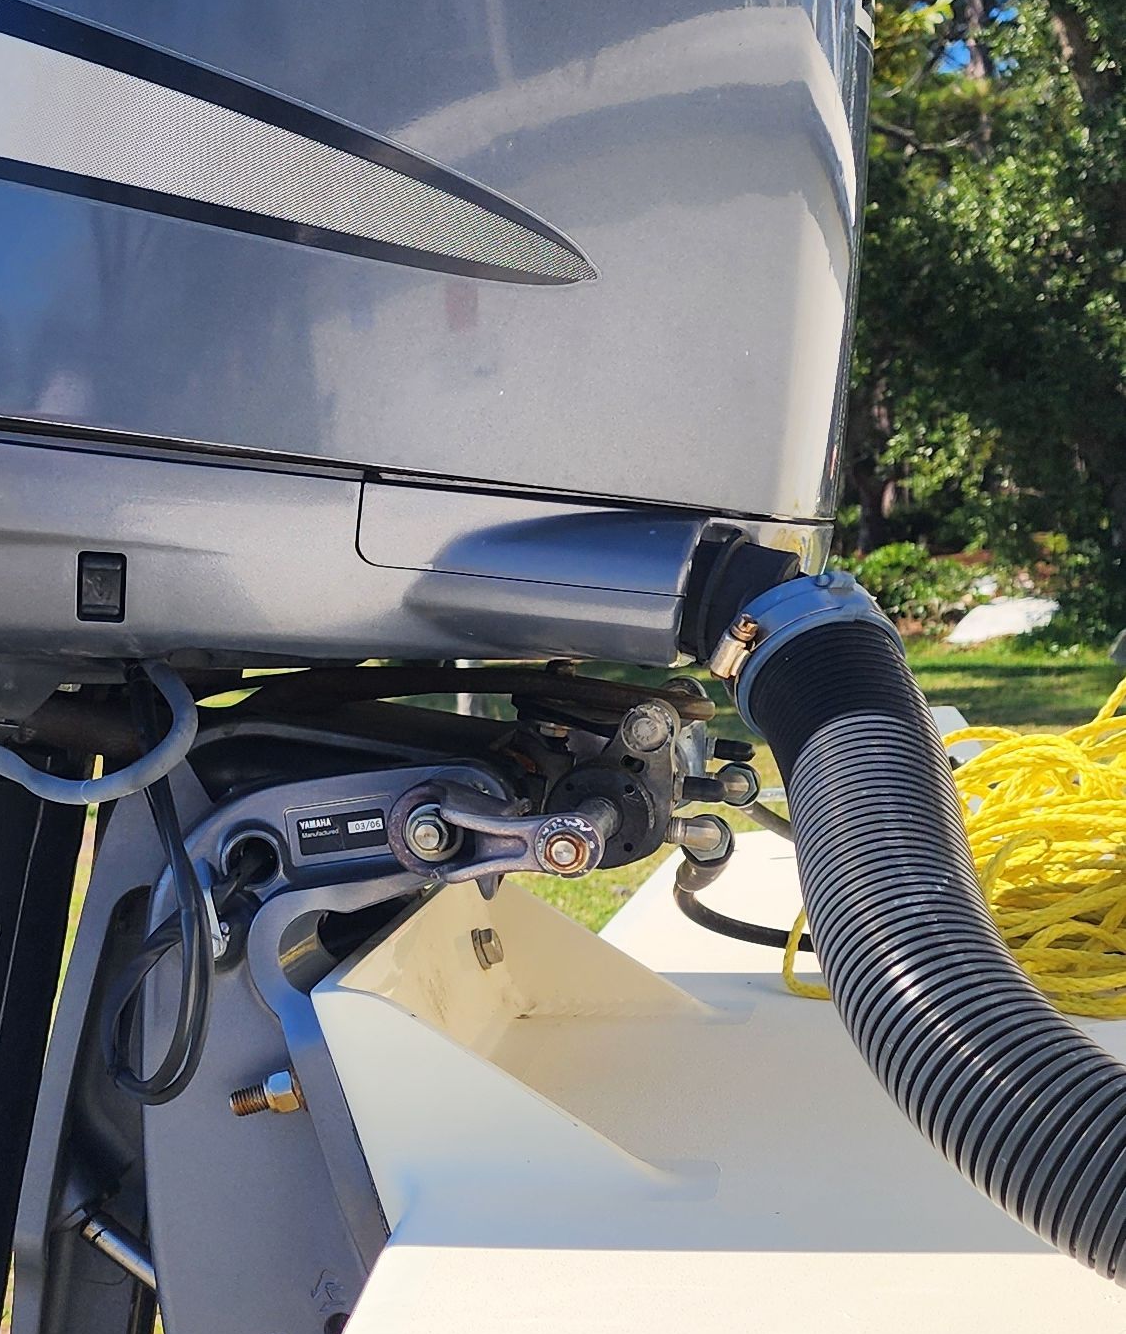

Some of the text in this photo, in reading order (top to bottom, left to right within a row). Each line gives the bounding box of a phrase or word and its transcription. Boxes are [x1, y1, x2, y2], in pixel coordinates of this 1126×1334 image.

[299, 817, 332, 829] YAMAHA
[354, 820, 381, 831] 03/06
[301, 828, 339, 839] Manufactured
